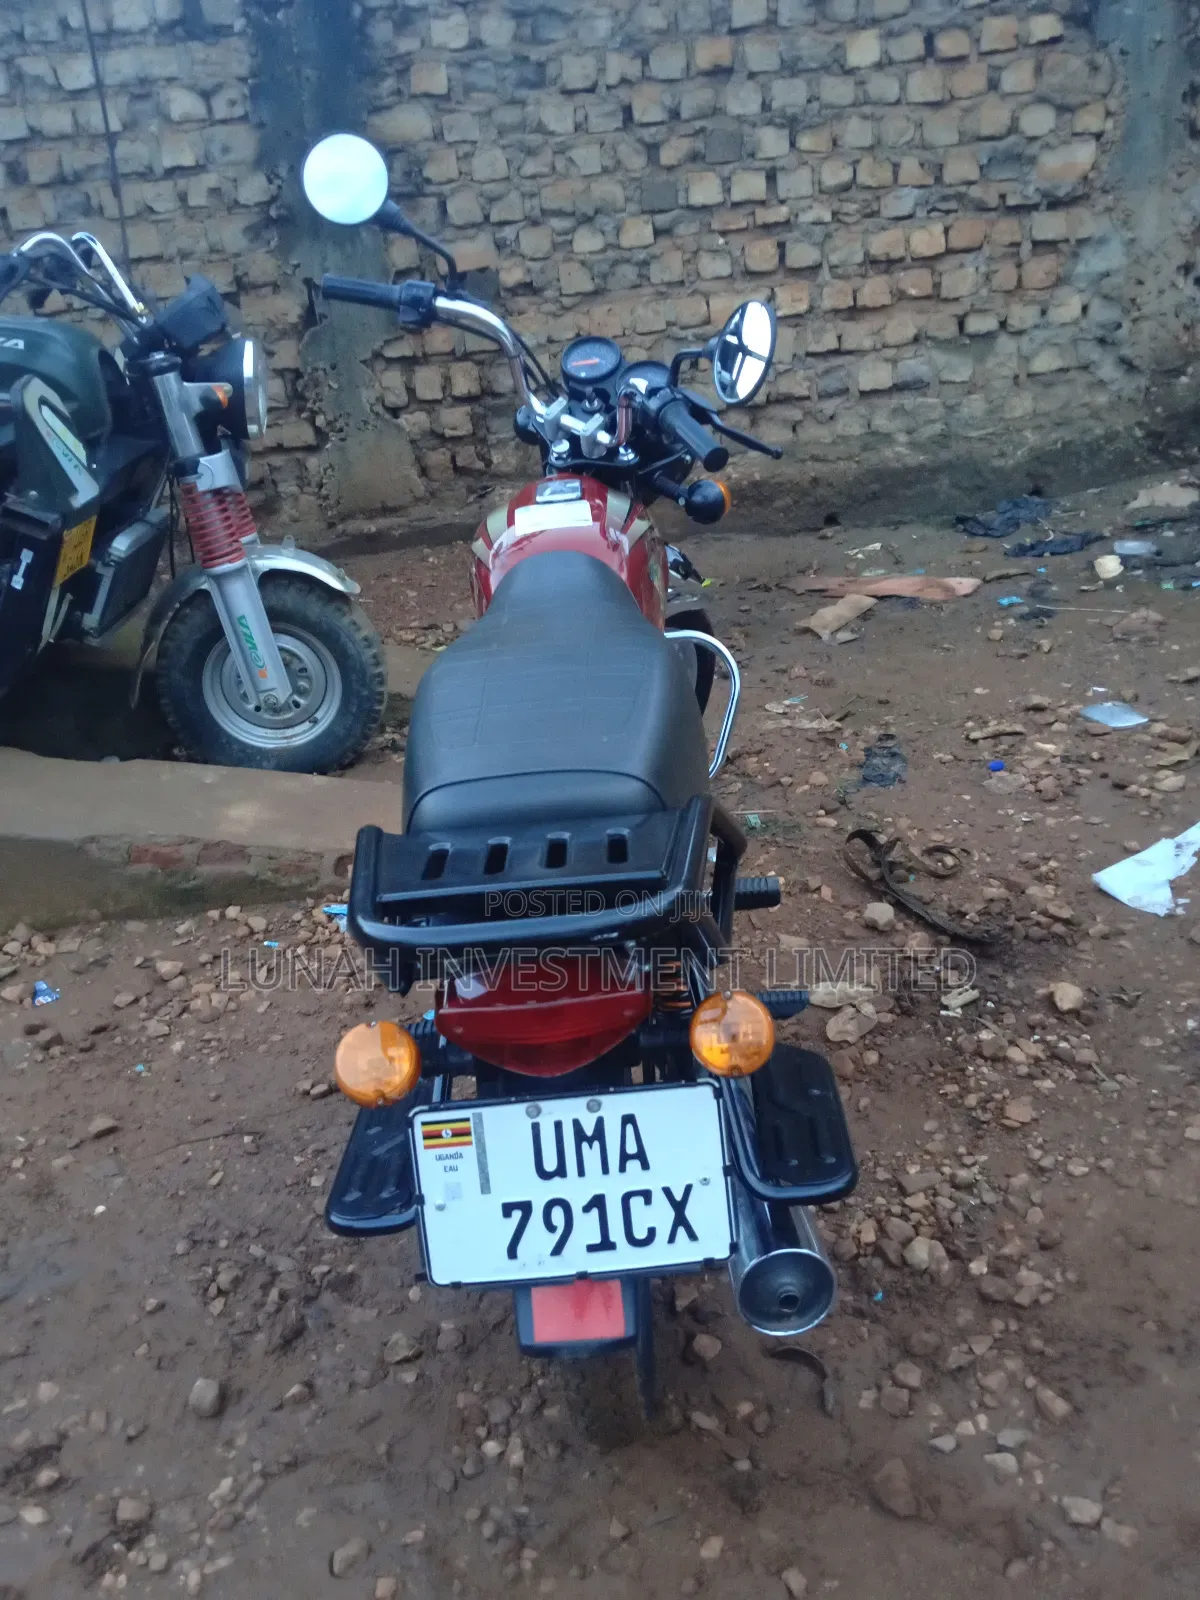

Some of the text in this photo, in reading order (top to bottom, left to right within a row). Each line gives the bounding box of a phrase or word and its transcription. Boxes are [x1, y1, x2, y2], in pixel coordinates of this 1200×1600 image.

[435, 1152, 464, 1162] UGANDA
[531, 1113, 651, 1181] UMA
[443, 1165, 459, 1173] EAU
[501, 1184, 699, 1260] 791CX
